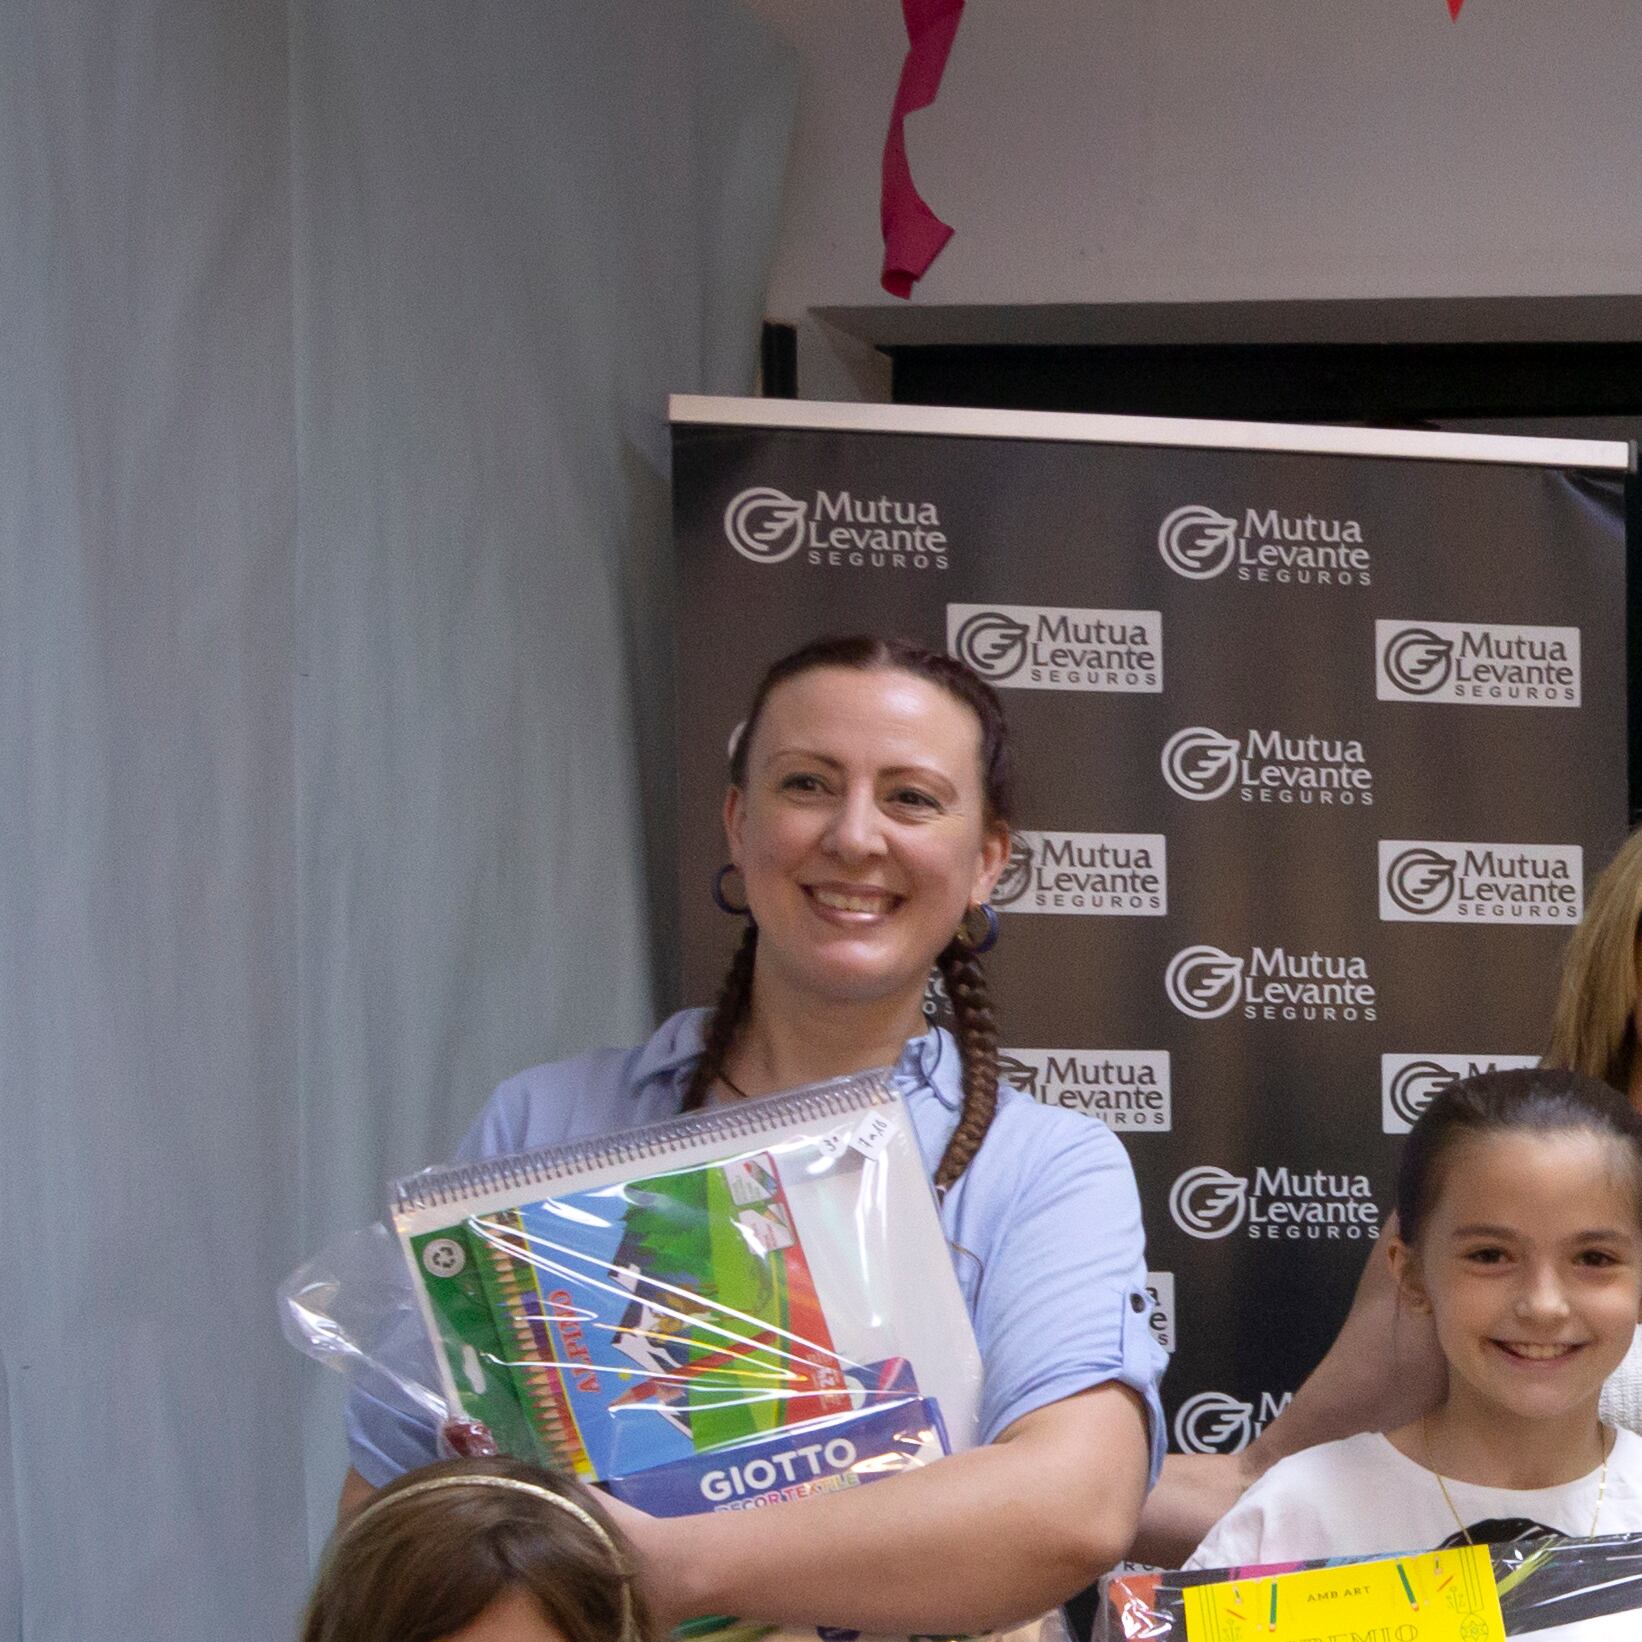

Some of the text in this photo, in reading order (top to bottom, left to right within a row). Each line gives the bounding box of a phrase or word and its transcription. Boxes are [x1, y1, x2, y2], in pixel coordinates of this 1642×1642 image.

[814, 491, 940, 526] Mutua
[809, 520, 948, 553] Levante
[1245, 509, 1362, 543] Mutua
[809, 552, 948, 570] SEGUROS
[1238, 538, 1370, 570] Levante
[1238, 568, 1370, 586] SEGUROS
[1036, 615, 1148, 646] Mutua
[1031, 644, 1155, 673] Levante
[1458, 631, 1567, 662] Mutua
[1031, 668, 1156, 685] SEGUROS
[1455, 659, 1573, 688] Levante
[1455, 684, 1574, 702] SEGUROS
[1247, 730, 1365, 764] Mutua
[1241, 759, 1372, 790] Levante
[1241, 788, 1373, 805] SEGUROS
[1040, 839, 1152, 870] Mutua
[1461, 852, 1570, 880] Mutua
[1036, 867, 1159, 896] Levante
[1458, 877, 1577, 904] Levante
[1036, 892, 1160, 909] SEGUROS
[1458, 902, 1577, 920] SEGUROS
[1249, 948, 1367, 981] Mutua
[1245, 977, 1376, 1006] Levante
[1245, 1005, 1377, 1023] SEGUROS
[1046, 1056, 1156, 1085] Mutua
[1040, 1085, 1163, 1109] Levante
[1254, 1167, 1370, 1197] Mutua
[1249, 1197, 1379, 1223] Levante
[1249, 1226, 1379, 1239] SEGUROS
[701, 1438, 856, 1501] GIOTTO
[784, 1472, 861, 1501] TEXTILE
[1307, 1585, 1371, 1603] AMB ART
